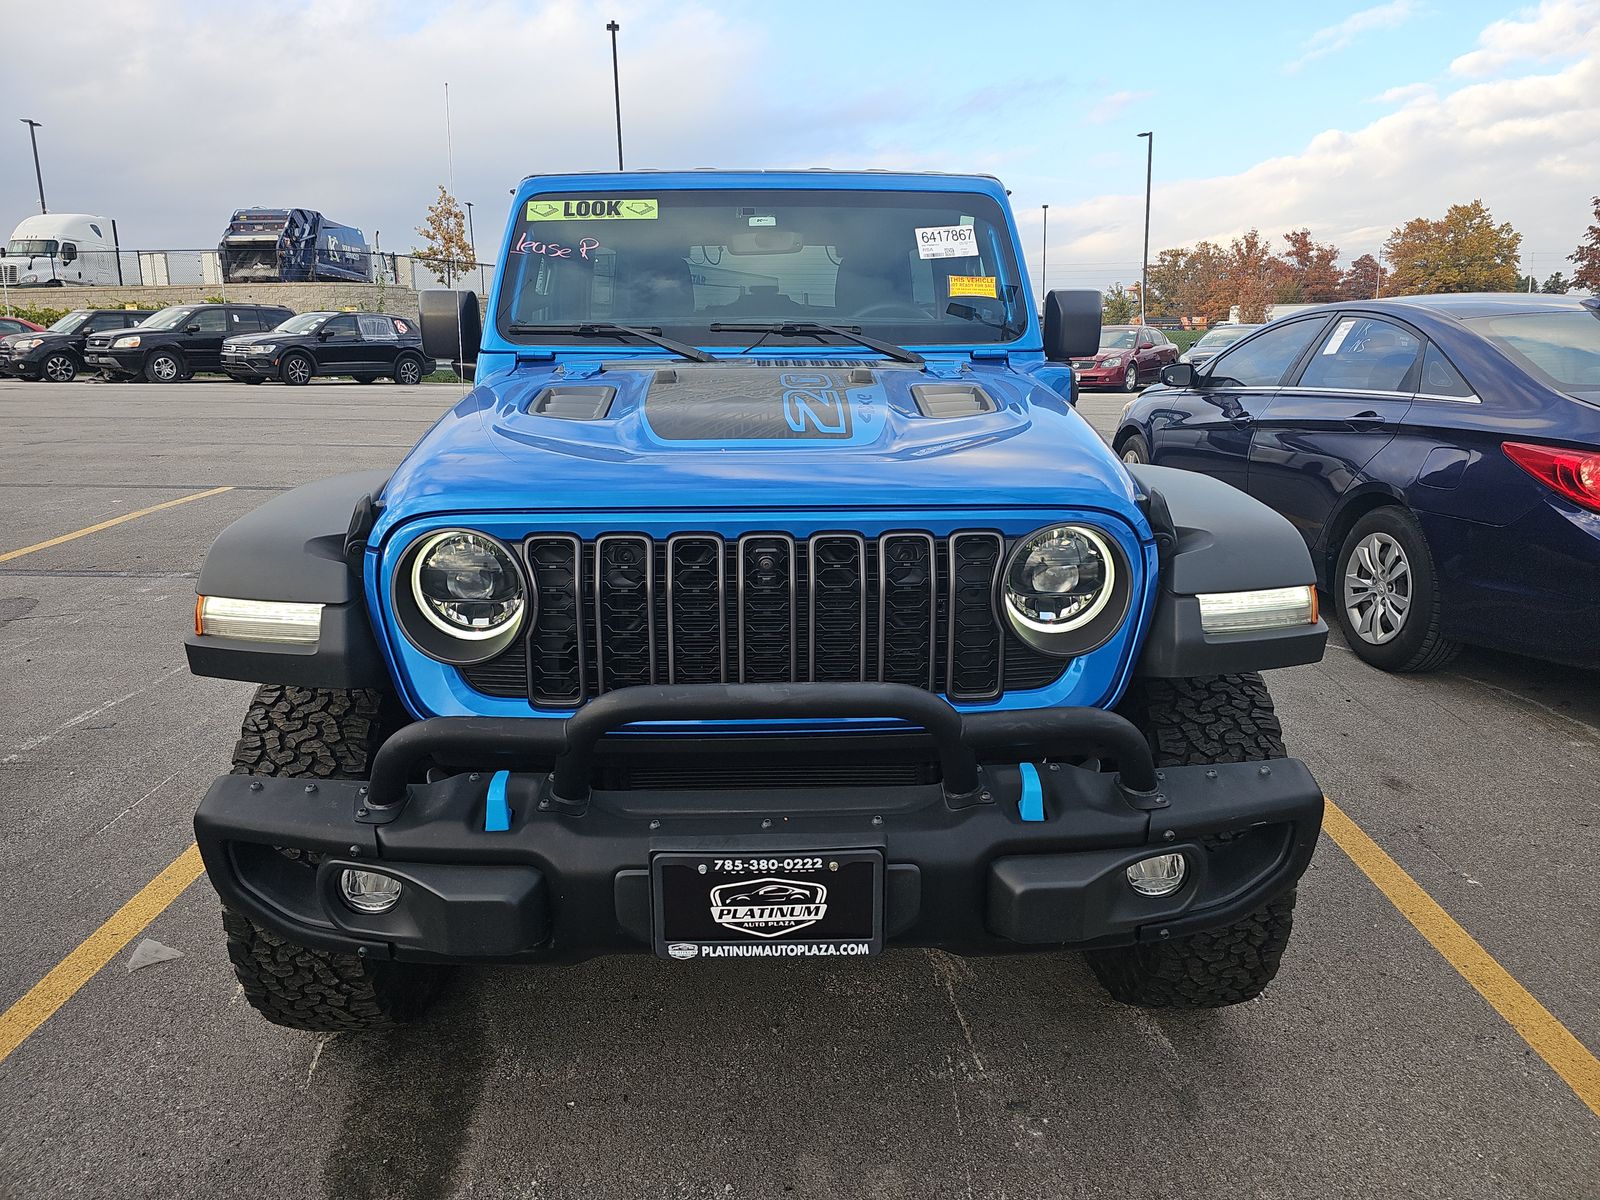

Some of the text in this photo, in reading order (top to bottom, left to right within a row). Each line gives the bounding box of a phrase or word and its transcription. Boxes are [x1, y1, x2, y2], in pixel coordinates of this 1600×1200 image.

[563, 200, 623, 218] LOOK
[921, 229, 972, 243] 6417867
[780, 373, 847, 434] 20
[714, 858, 823, 871] 785-380-0222
[718, 906, 820, 919] PLATINUM
[701, 944, 870, 958] PLATINUMAUTOPLAZA.COM
